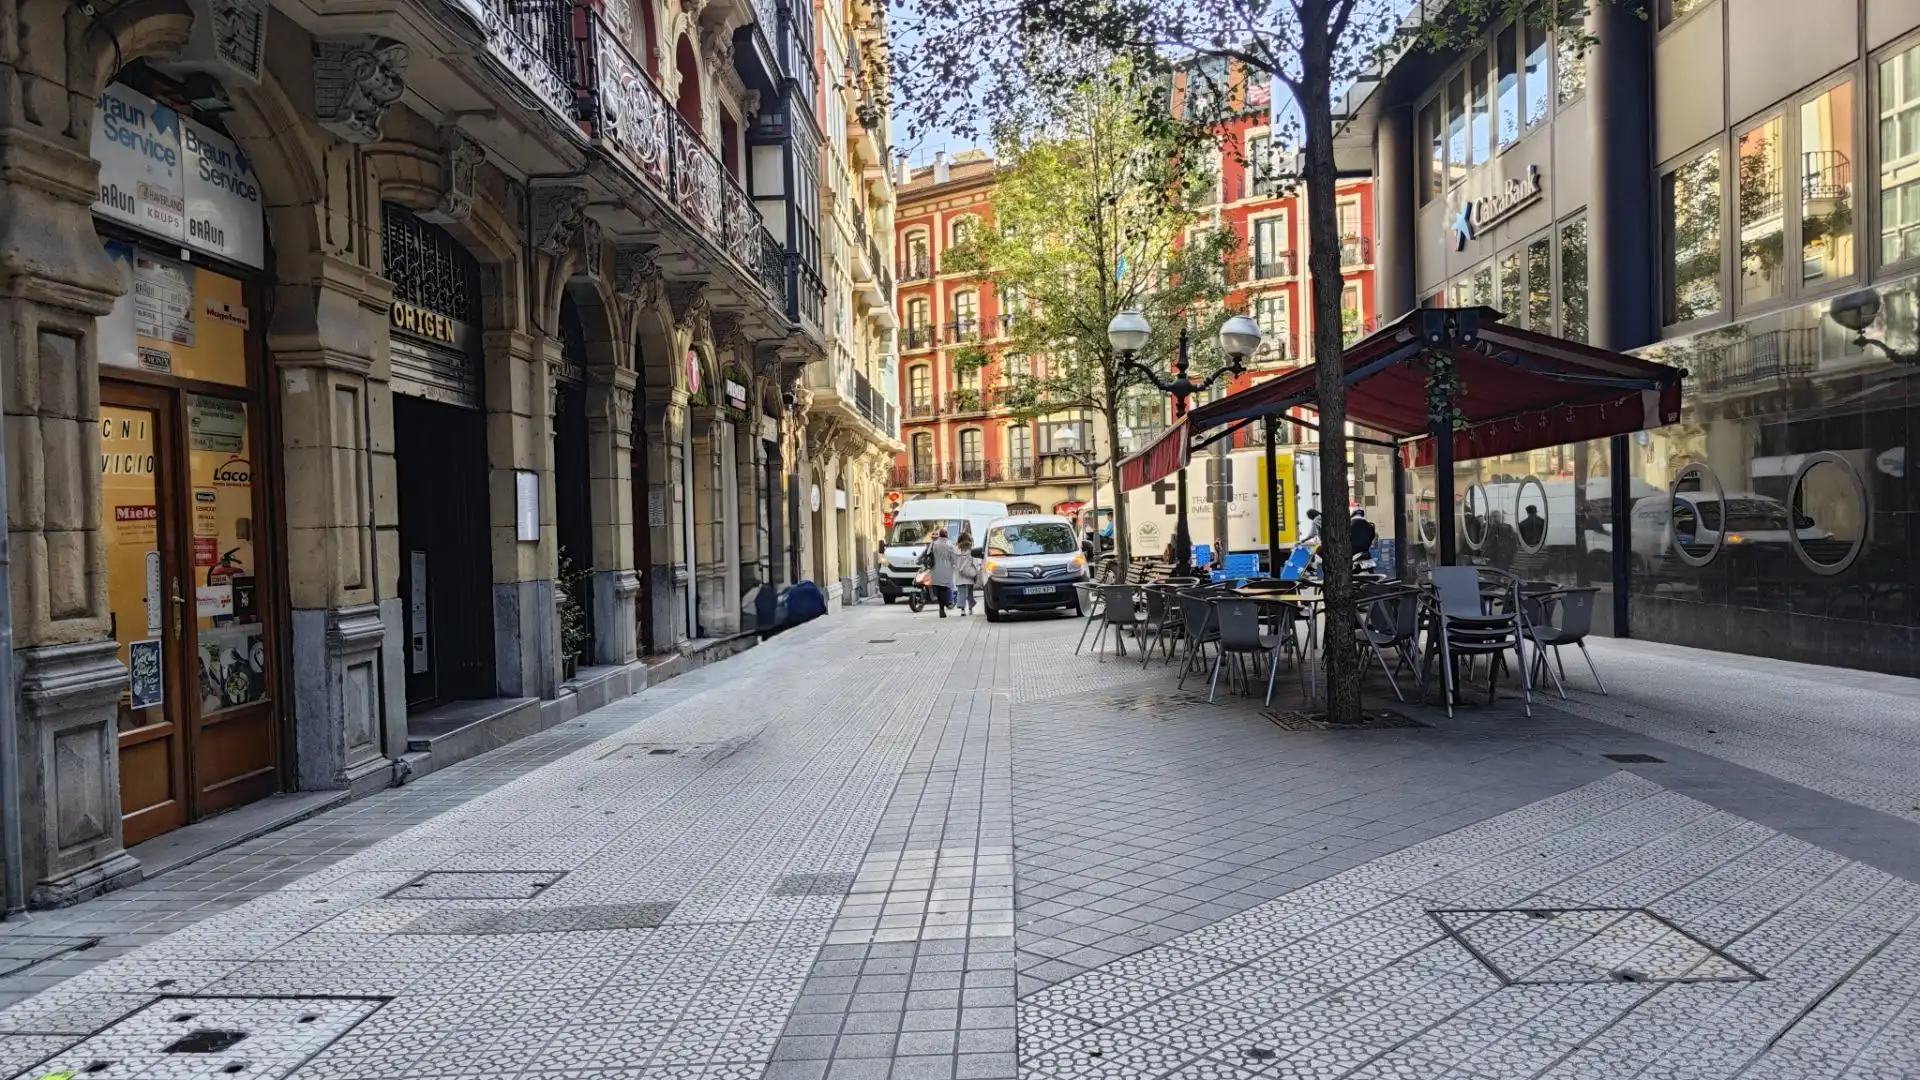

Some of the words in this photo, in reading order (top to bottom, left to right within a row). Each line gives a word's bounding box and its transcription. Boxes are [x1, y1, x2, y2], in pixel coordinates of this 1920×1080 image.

[104, 113, 176, 167] Service
[186, 128, 231, 169] Braun
[199, 157, 257, 201] Service
[1473, 164, 1541, 226] CaixaBank
[98, 184, 135, 215] RAUN
[147, 207, 179, 228] KRUPS
[190, 218, 224, 247] BRAUN
[394, 302, 455, 342] ORIGEN
[213, 468, 255, 482] Lacor
[116, 507, 157, 520] Miele
